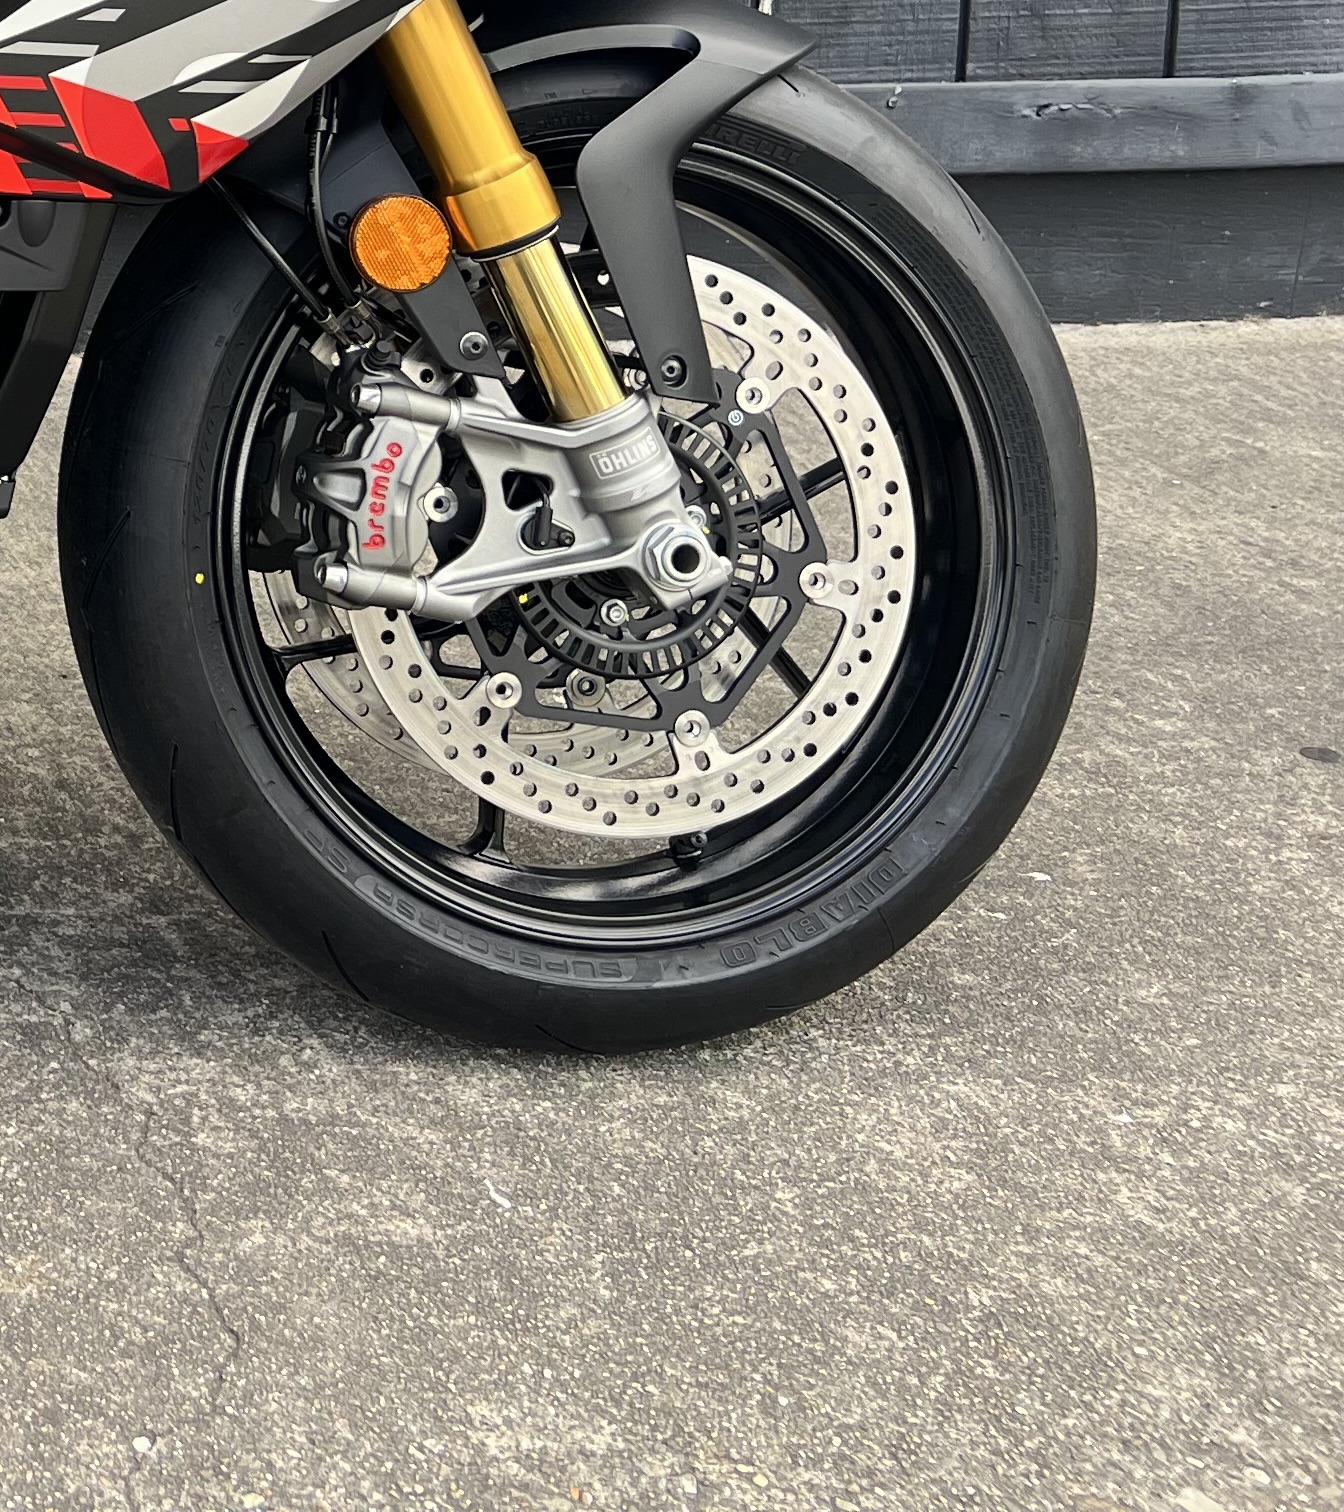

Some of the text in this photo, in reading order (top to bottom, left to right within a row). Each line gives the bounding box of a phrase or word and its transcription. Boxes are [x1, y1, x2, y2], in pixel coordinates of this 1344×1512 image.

[362, 441, 403, 551] brembo
[366, 882, 624, 980] SUPERCORSA
[720, 847, 909, 969] DIABLO
